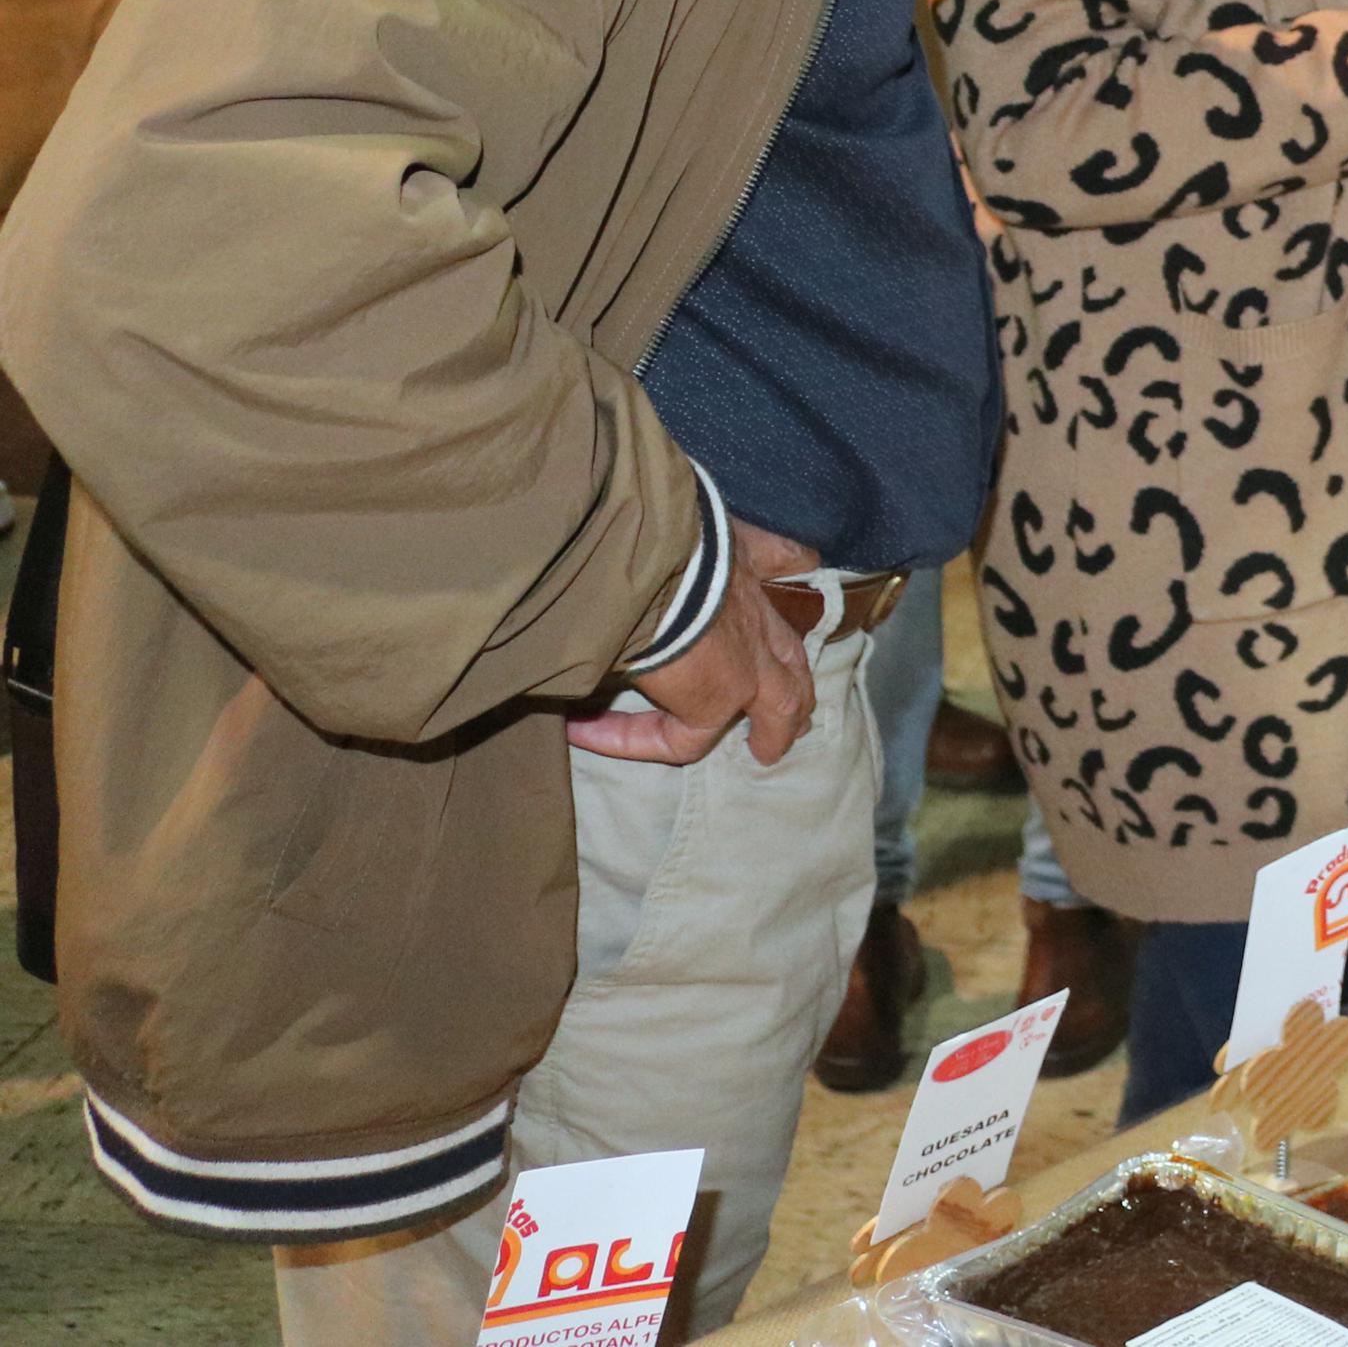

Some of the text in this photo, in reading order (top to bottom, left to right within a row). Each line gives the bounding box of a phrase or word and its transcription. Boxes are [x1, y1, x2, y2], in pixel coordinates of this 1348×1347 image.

[902, 1125, 1017, 1188] CHOCOLATE
[921, 1109, 1010, 1157] QUESADA
[607, 1312, 662, 1333] ALPE
